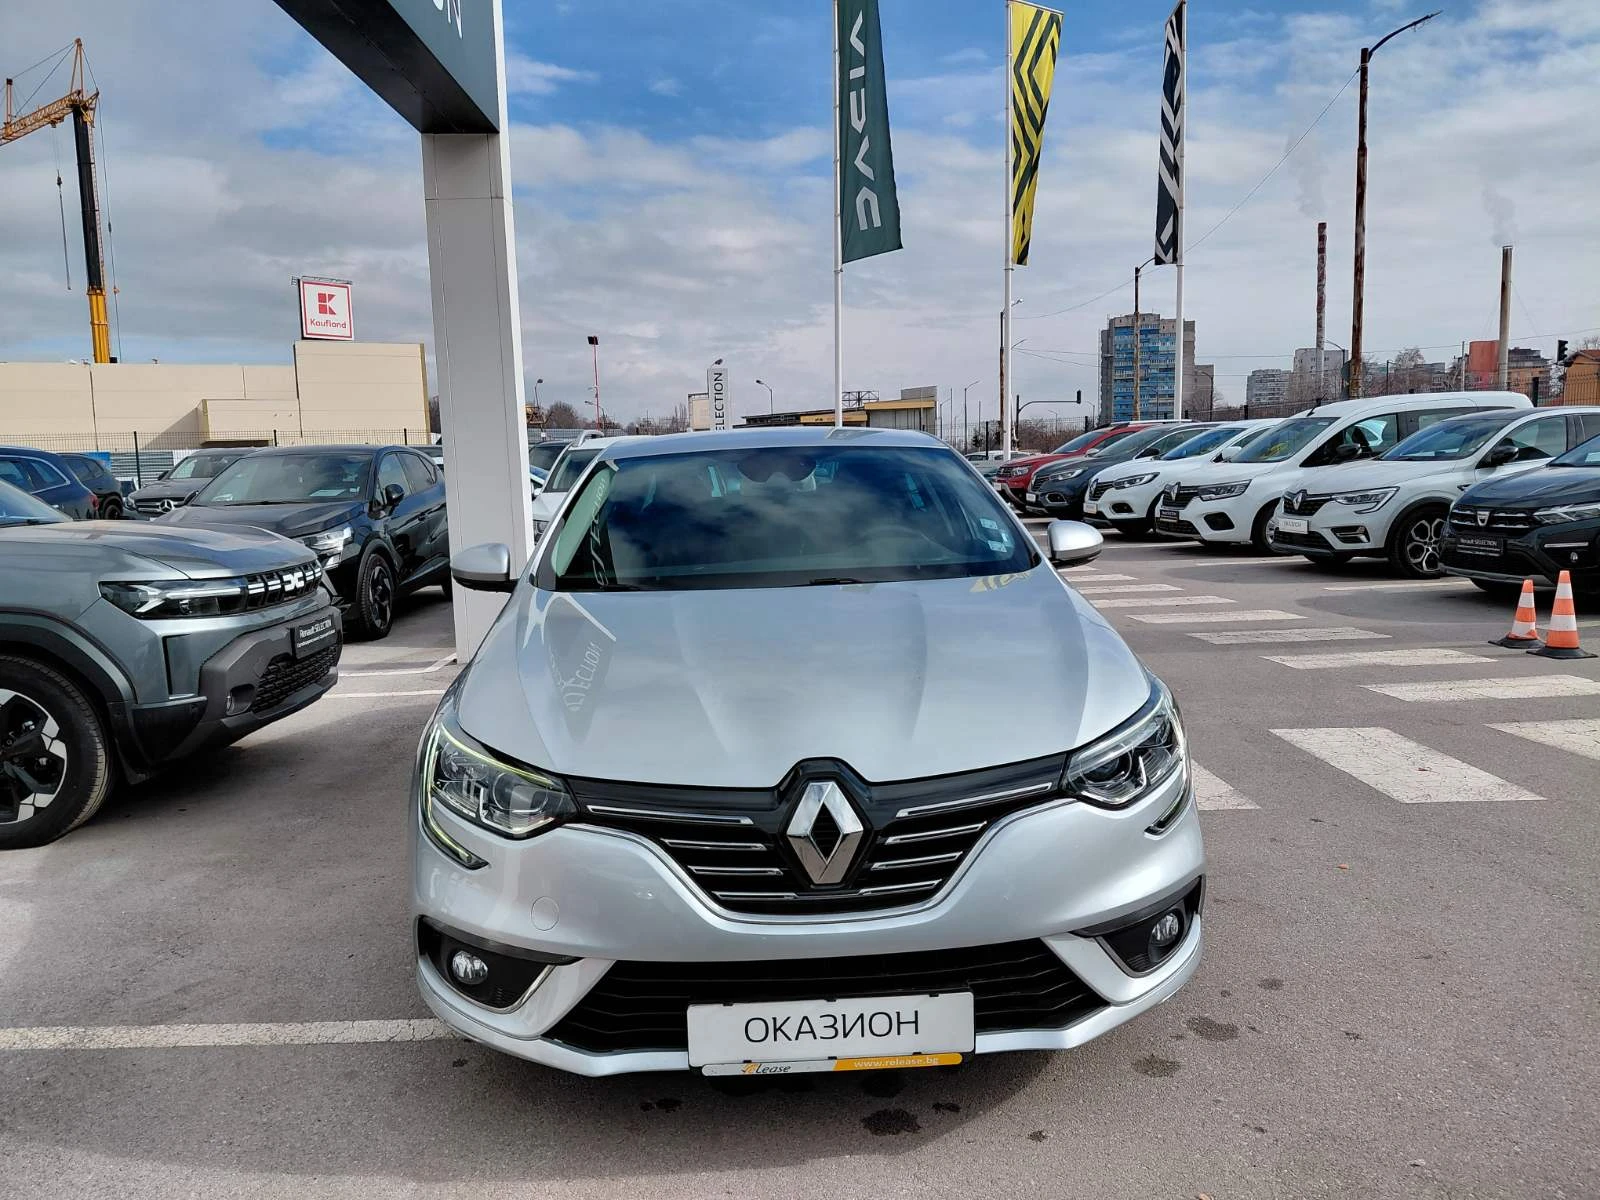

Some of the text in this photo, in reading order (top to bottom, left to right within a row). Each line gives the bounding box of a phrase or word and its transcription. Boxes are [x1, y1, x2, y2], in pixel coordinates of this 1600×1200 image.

[850, 10, 881, 230] DACIA
[310, 318, 347, 329] Kaufland
[744, 1010, 919, 1043] ОКАЗИОН
[853, 1056, 940, 1067] www.release.bg
